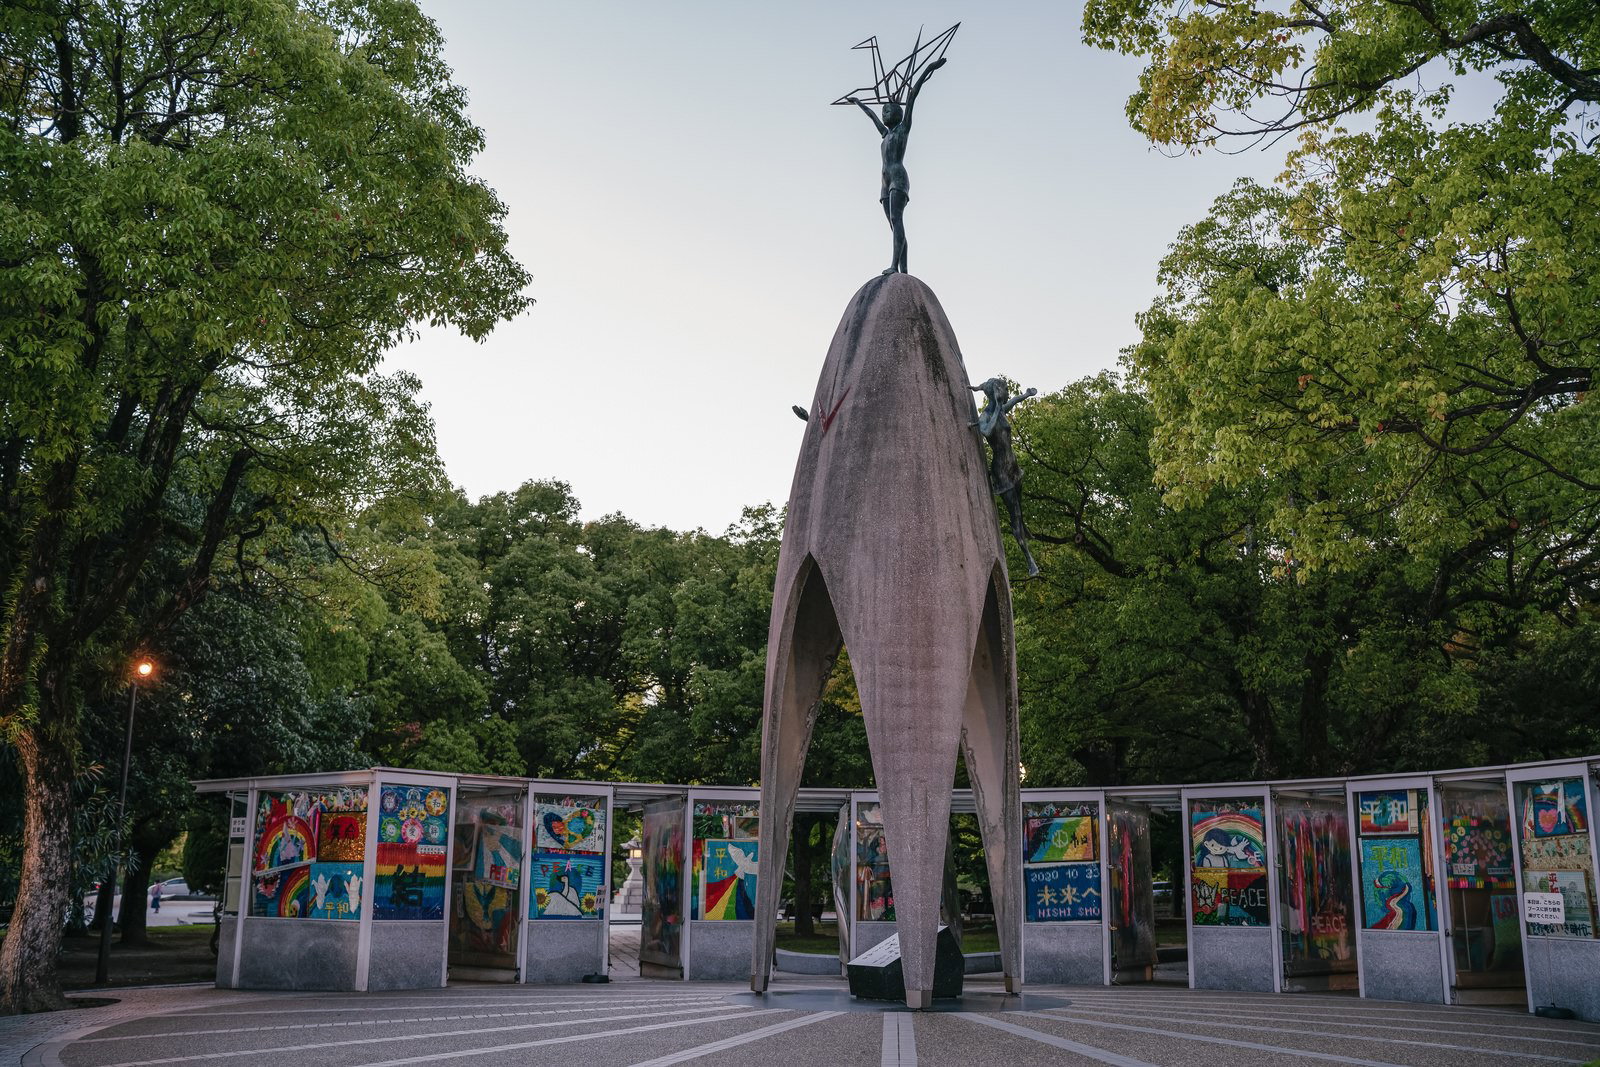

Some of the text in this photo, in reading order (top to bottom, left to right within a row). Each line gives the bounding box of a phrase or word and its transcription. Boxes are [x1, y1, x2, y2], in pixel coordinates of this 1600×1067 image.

[541, 860, 594, 877] PEACE
[714, 847, 728, 879] 平和
[1030, 870, 1059, 883] 2020
[1065, 868, 1079, 880] 10
[1036, 883, 1101, 907] 未来へ
[1221, 888, 1267, 908] PEACE
[322, 899, 349, 920] 平和
[1311, 915, 1347, 933] PEACE
